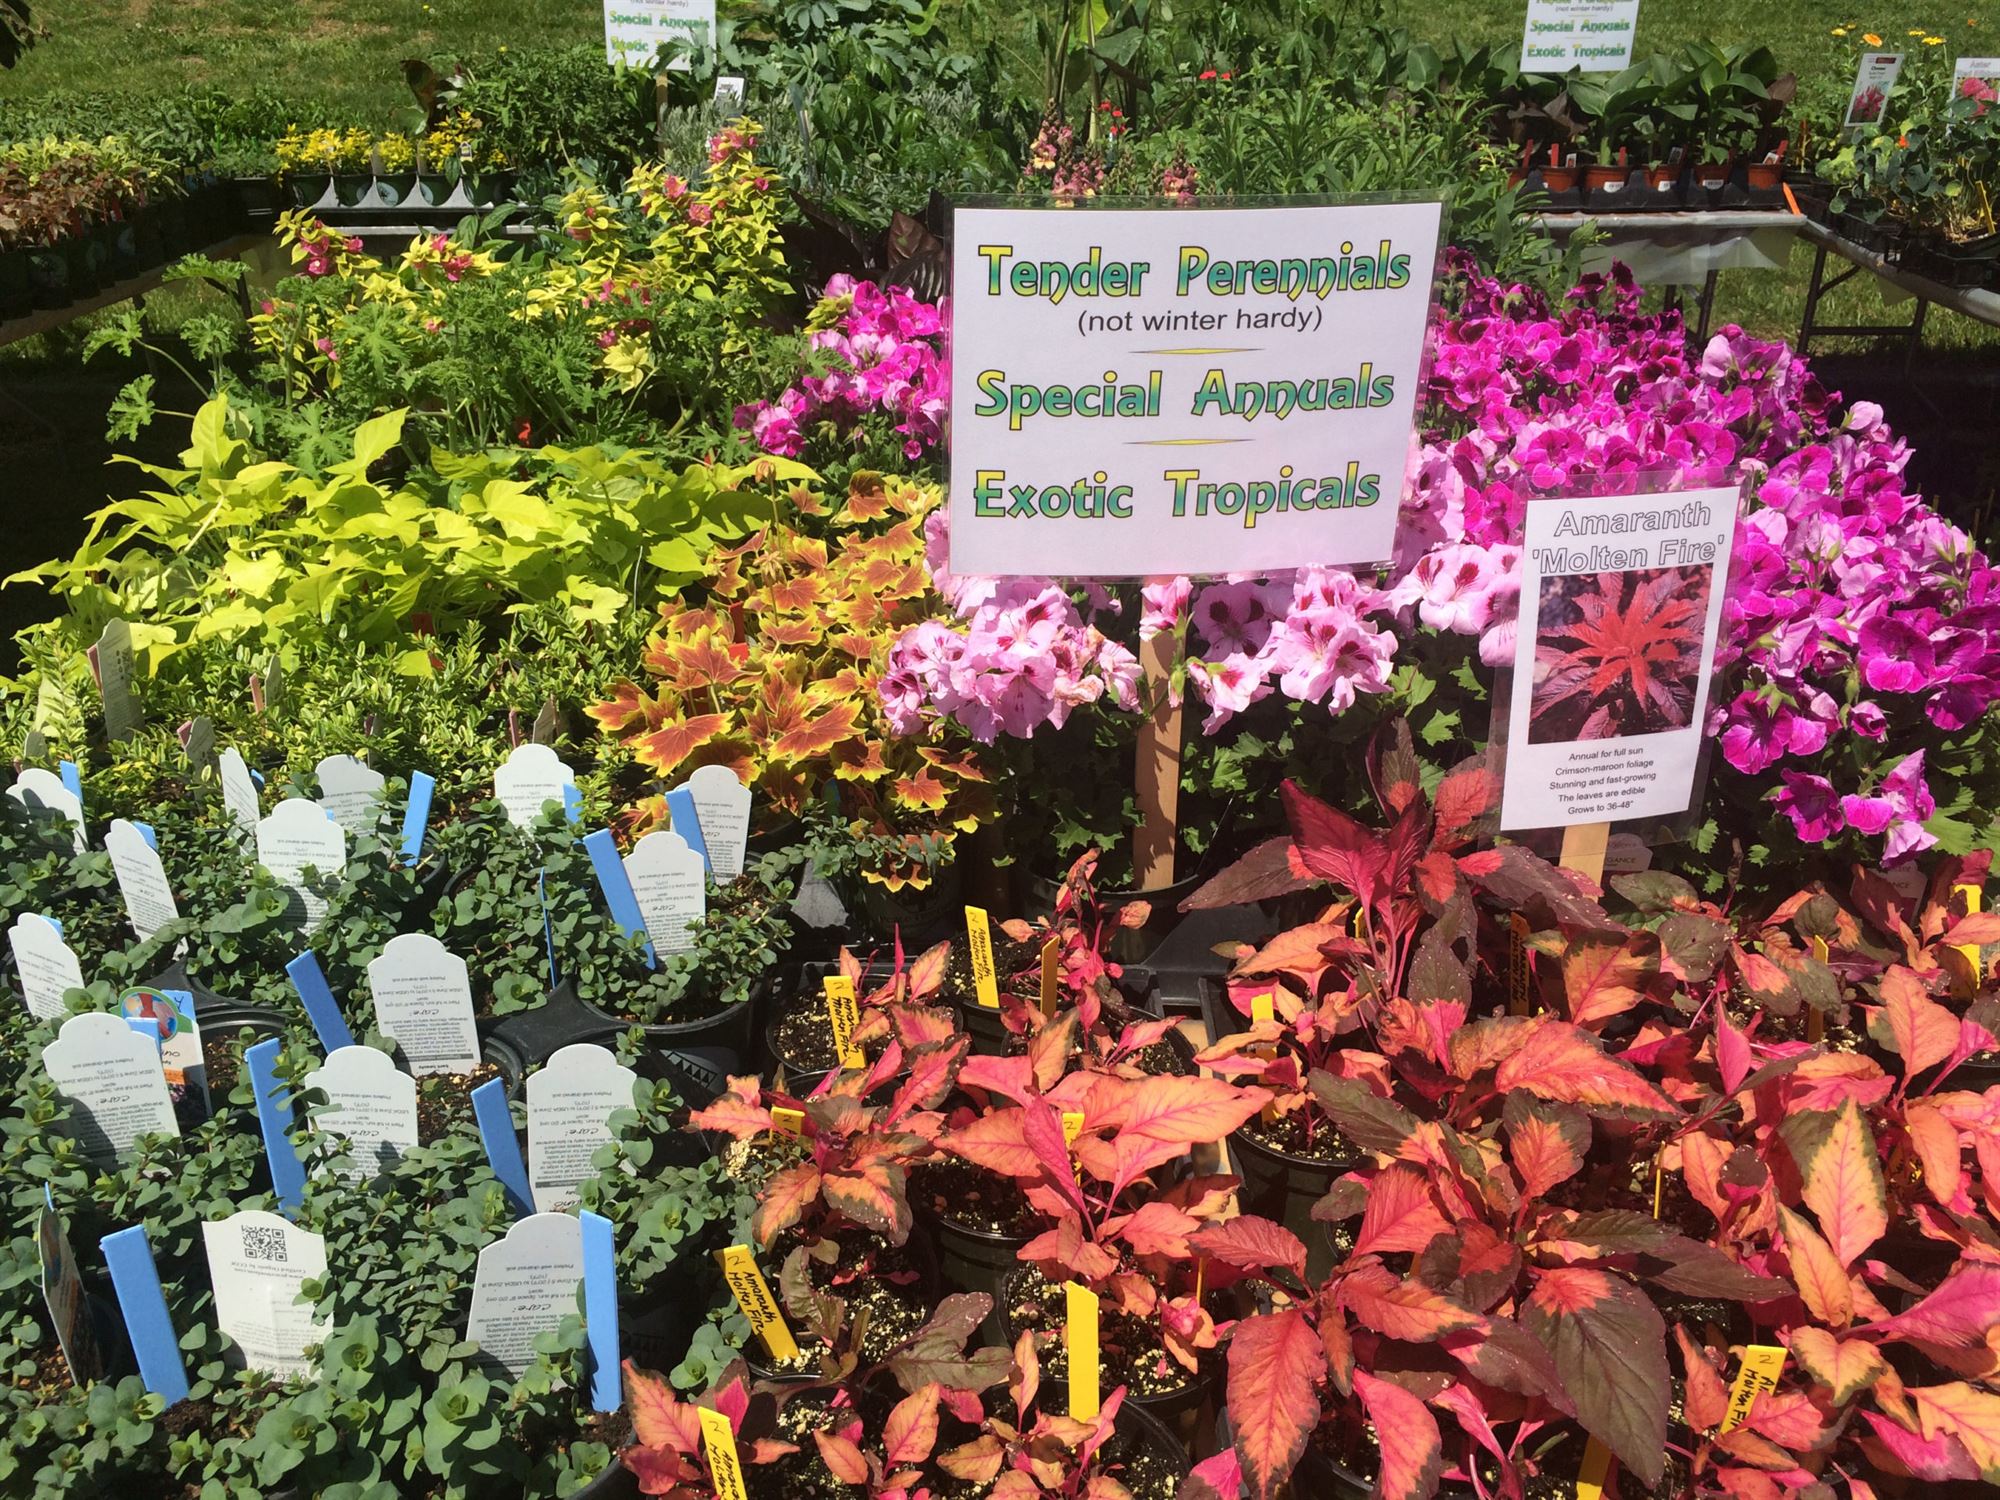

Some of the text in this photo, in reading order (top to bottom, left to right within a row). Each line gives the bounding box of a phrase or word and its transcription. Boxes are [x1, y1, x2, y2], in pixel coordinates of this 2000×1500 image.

[609, 10, 653, 28] Special
[1530, 18, 1630, 36] Special Annuals
[1527, 43, 1626, 61] Exotic Tropicals
[978, 239, 1411, 305] Tender Perennials
[1077, 305, 1323, 337] (not winter hardy)
[974, 362, 1395, 431] Special Annuals
[973, 461, 1381, 529] Exotic Tropicals
[1553, 501, 1711, 537] Amaranth
[1532, 534, 1725, 575] 'Molten Fire'
[1568, 747, 1644, 761] Annual for full sun
[1555, 760, 1654, 776] Crimson-maroon foliage
[1549, 772, 1657, 790] Stunning and fast-growing
[1558, 786, 1646, 802] The leaves are edible
[1567, 806, 1595, 815] Grows
[1596, 804, 1605, 812] to
[728, 1272, 751, 1306] Molten
[742, 1271, 777, 1323] Amaranth
